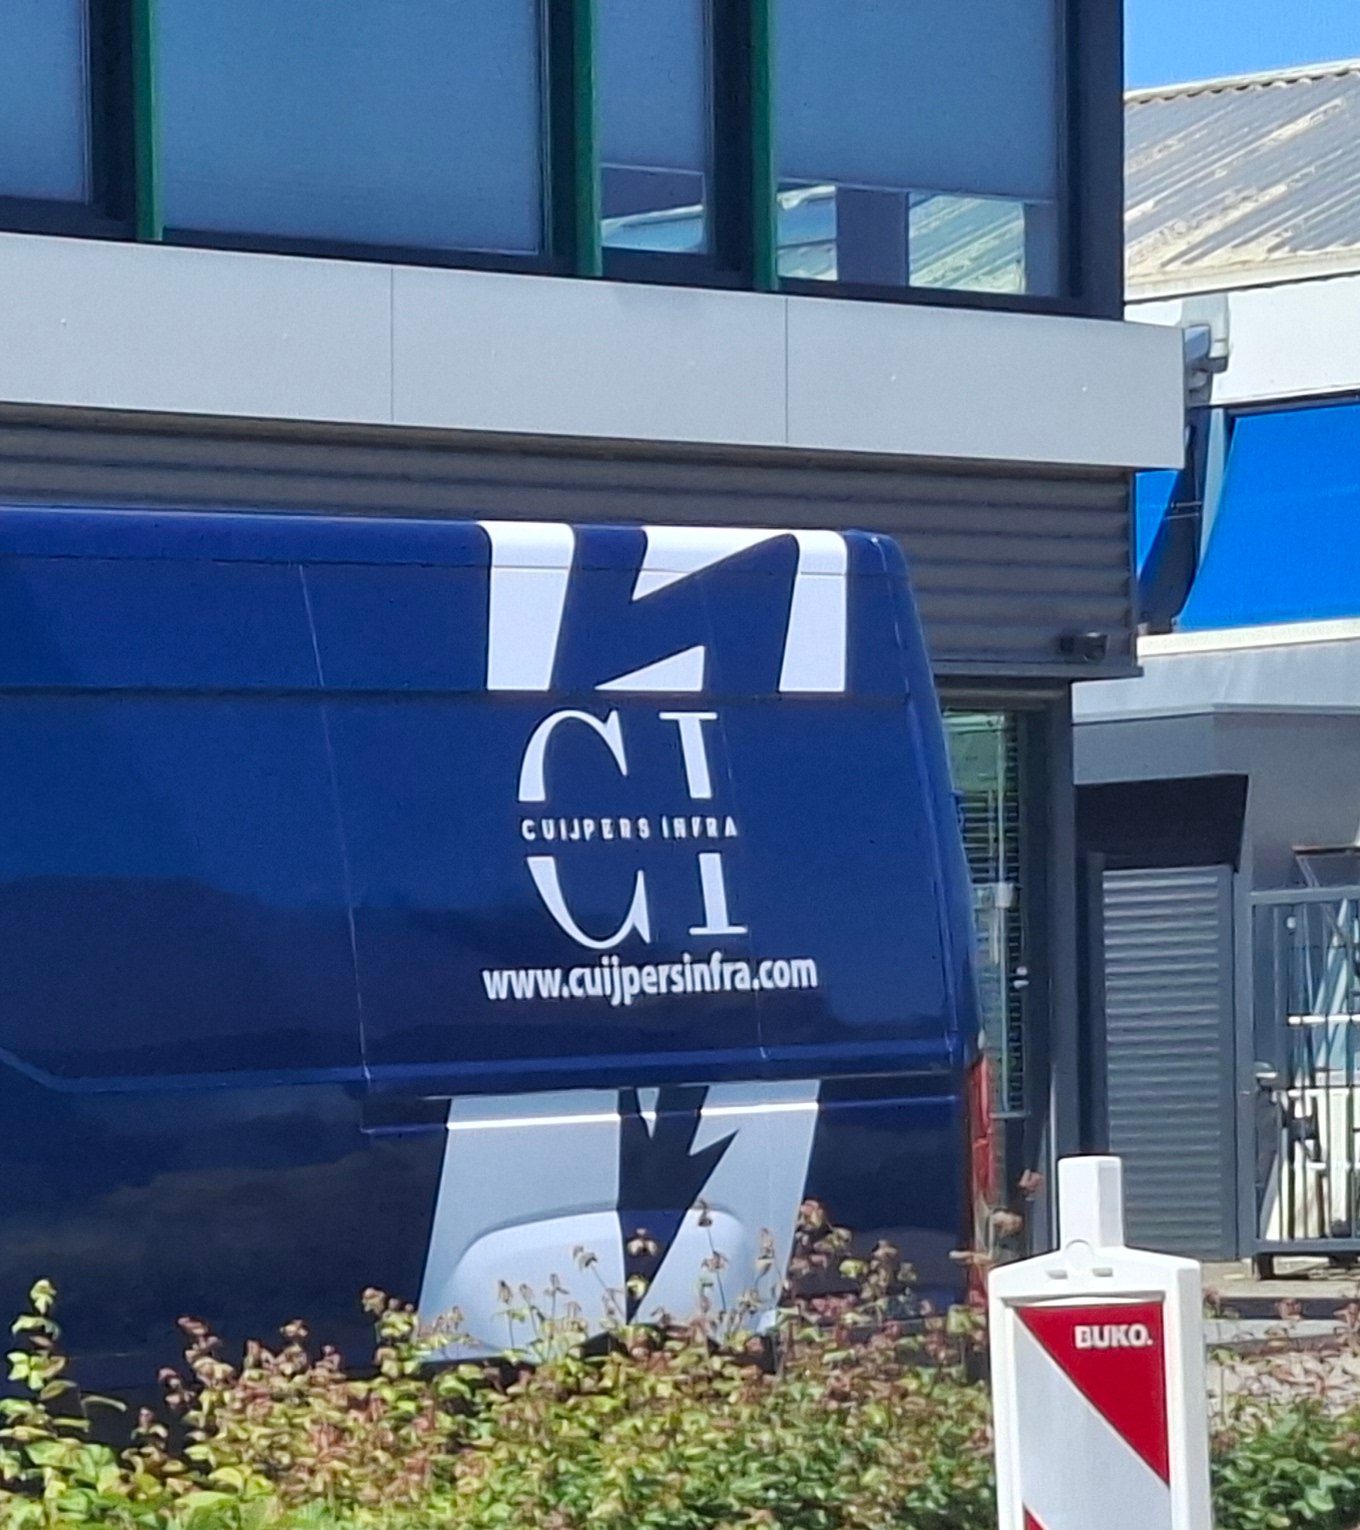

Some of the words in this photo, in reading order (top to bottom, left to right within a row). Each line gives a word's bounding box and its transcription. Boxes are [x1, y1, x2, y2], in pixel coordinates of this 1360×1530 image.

[521, 816, 651, 841] CUIJPERS
[661, 815, 738, 838] INFRA
[482, 951, 818, 1006] www.cuijpersinfra.com
[1075, 1323, 1153, 1348] BUKO.
